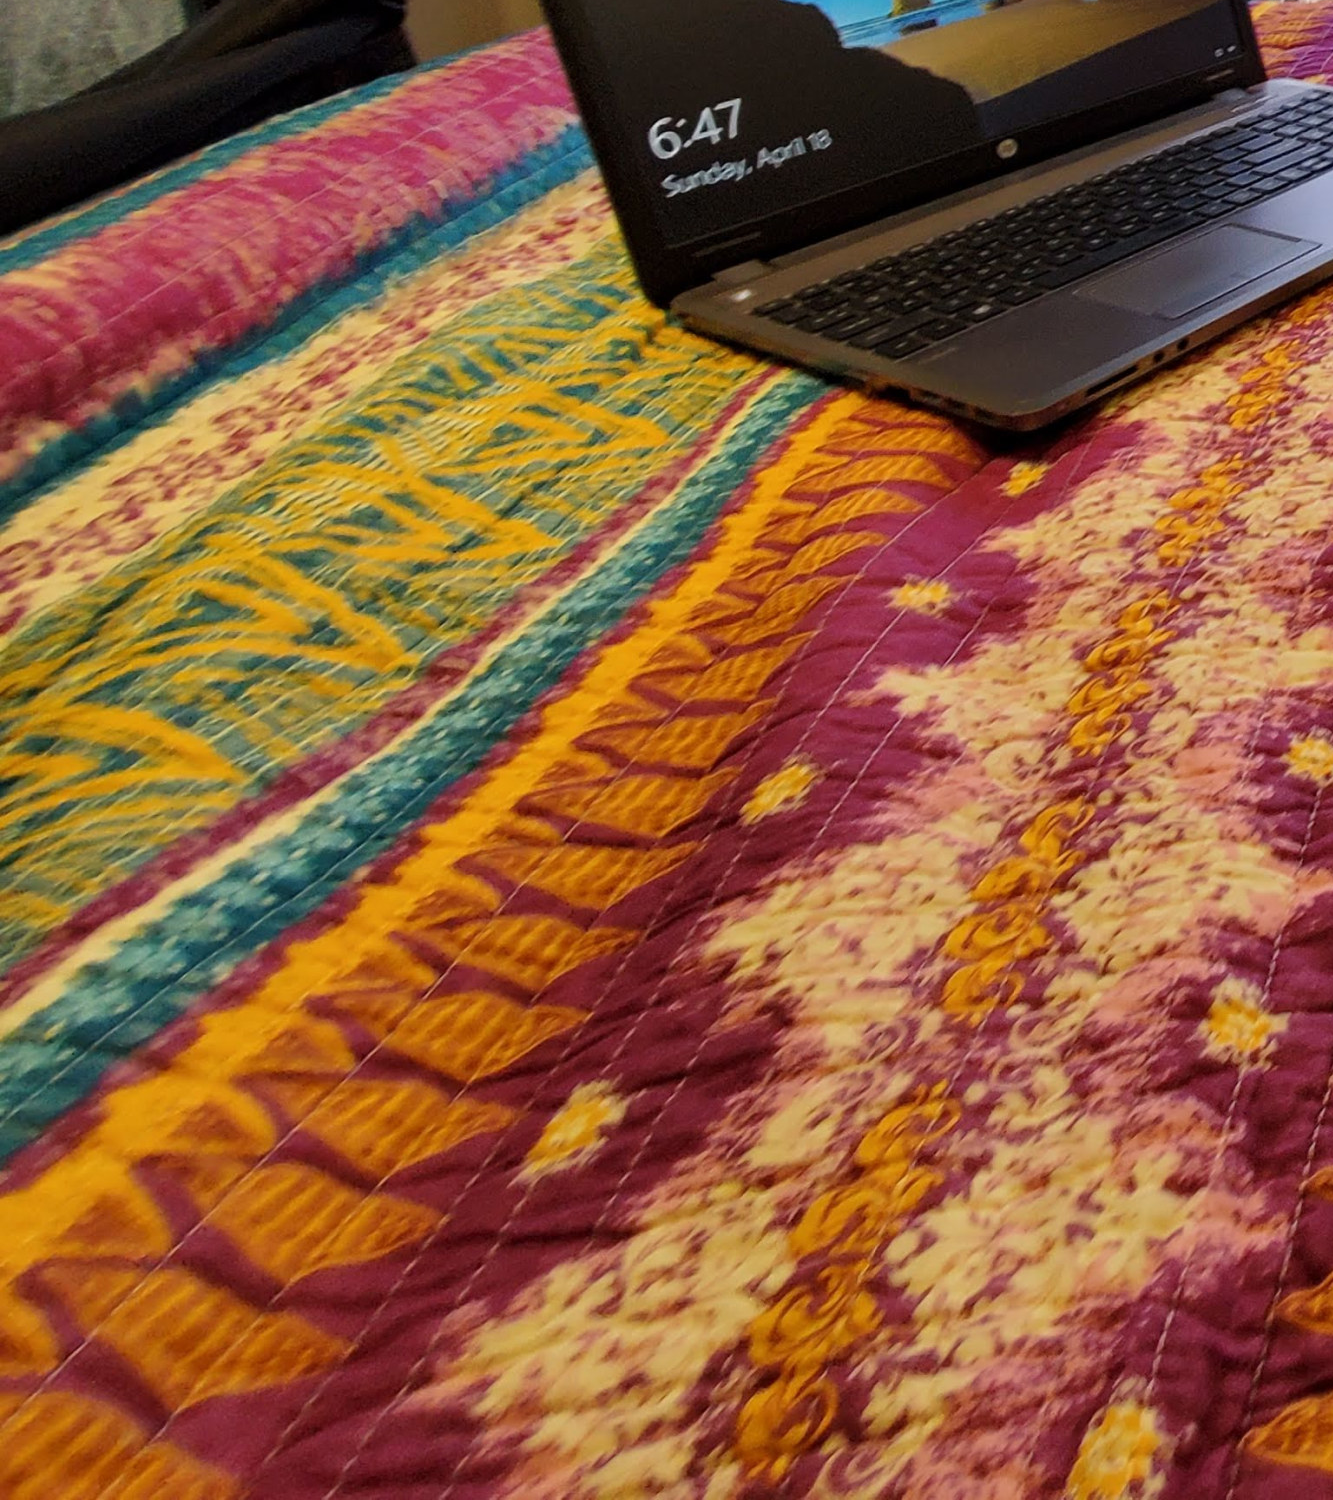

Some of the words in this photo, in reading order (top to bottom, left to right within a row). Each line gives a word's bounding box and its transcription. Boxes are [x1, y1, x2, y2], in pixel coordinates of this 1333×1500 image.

[648, 97, 742, 160] 6:47
[661, 159, 754, 198] Sunday,
[756, 136, 807, 169] April
[806, 128, 833, 151] 18
